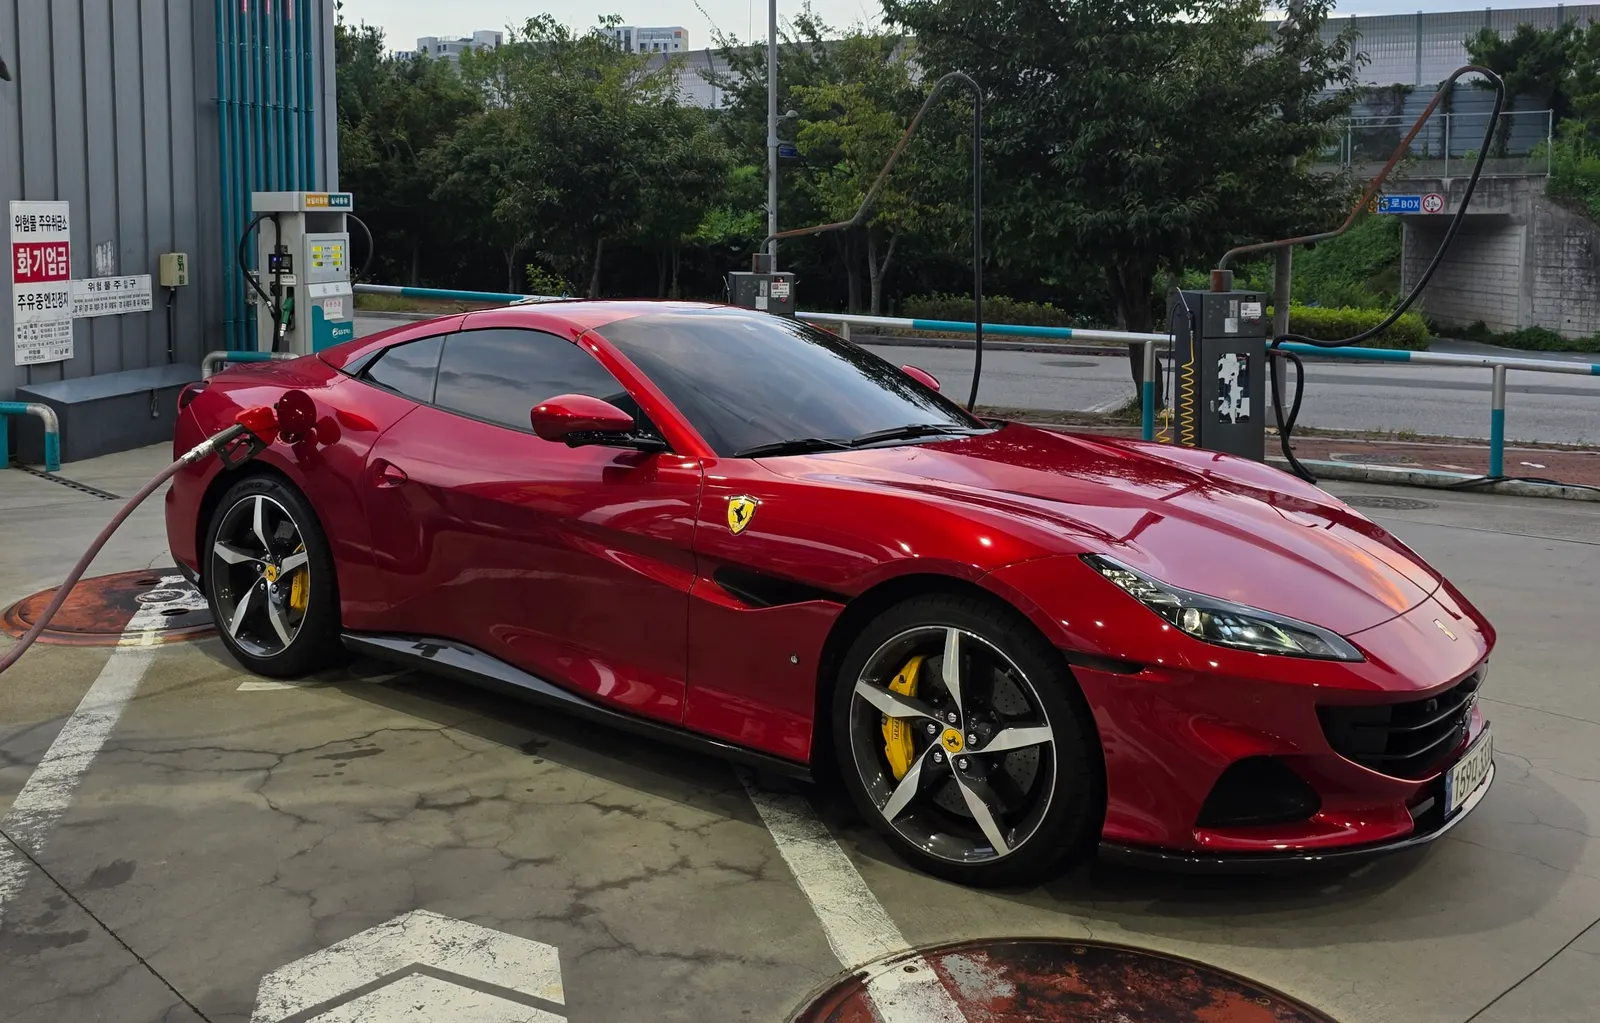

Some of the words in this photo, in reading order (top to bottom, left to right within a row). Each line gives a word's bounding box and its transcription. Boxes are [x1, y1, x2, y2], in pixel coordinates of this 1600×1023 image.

[15, 214, 37, 232] 위험물
[39, 214, 67, 232] 주유취급소
[17, 246, 67, 277] 화기엄금
[87, 279, 136, 292] 위험물주입구
[17, 291, 69, 311] 주유중엔진정지
